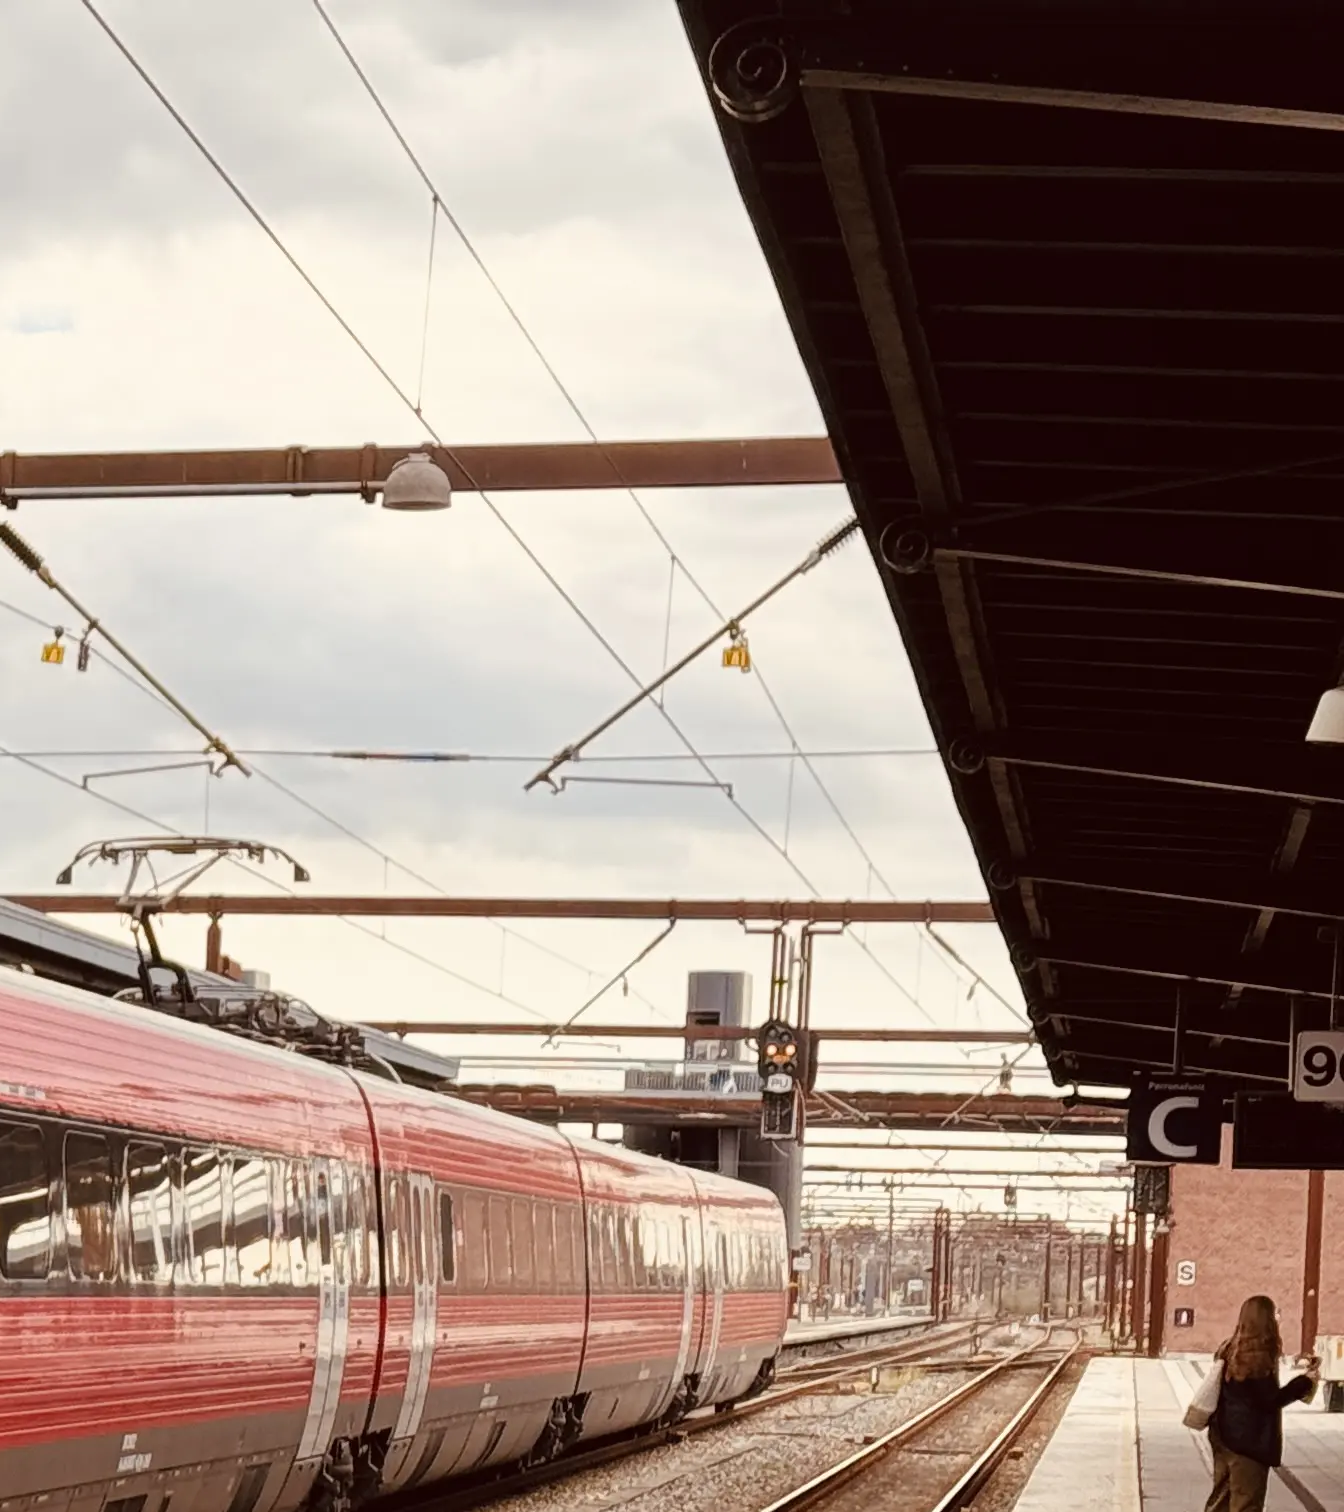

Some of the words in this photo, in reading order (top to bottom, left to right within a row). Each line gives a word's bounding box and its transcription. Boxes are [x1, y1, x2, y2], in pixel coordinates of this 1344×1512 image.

[1303, 1045, 1344, 1088] 9
[771, 1078, 789, 1088] PU
[1148, 1096, 1199, 1158] C
[1180, 1265, 1193, 1280] S
